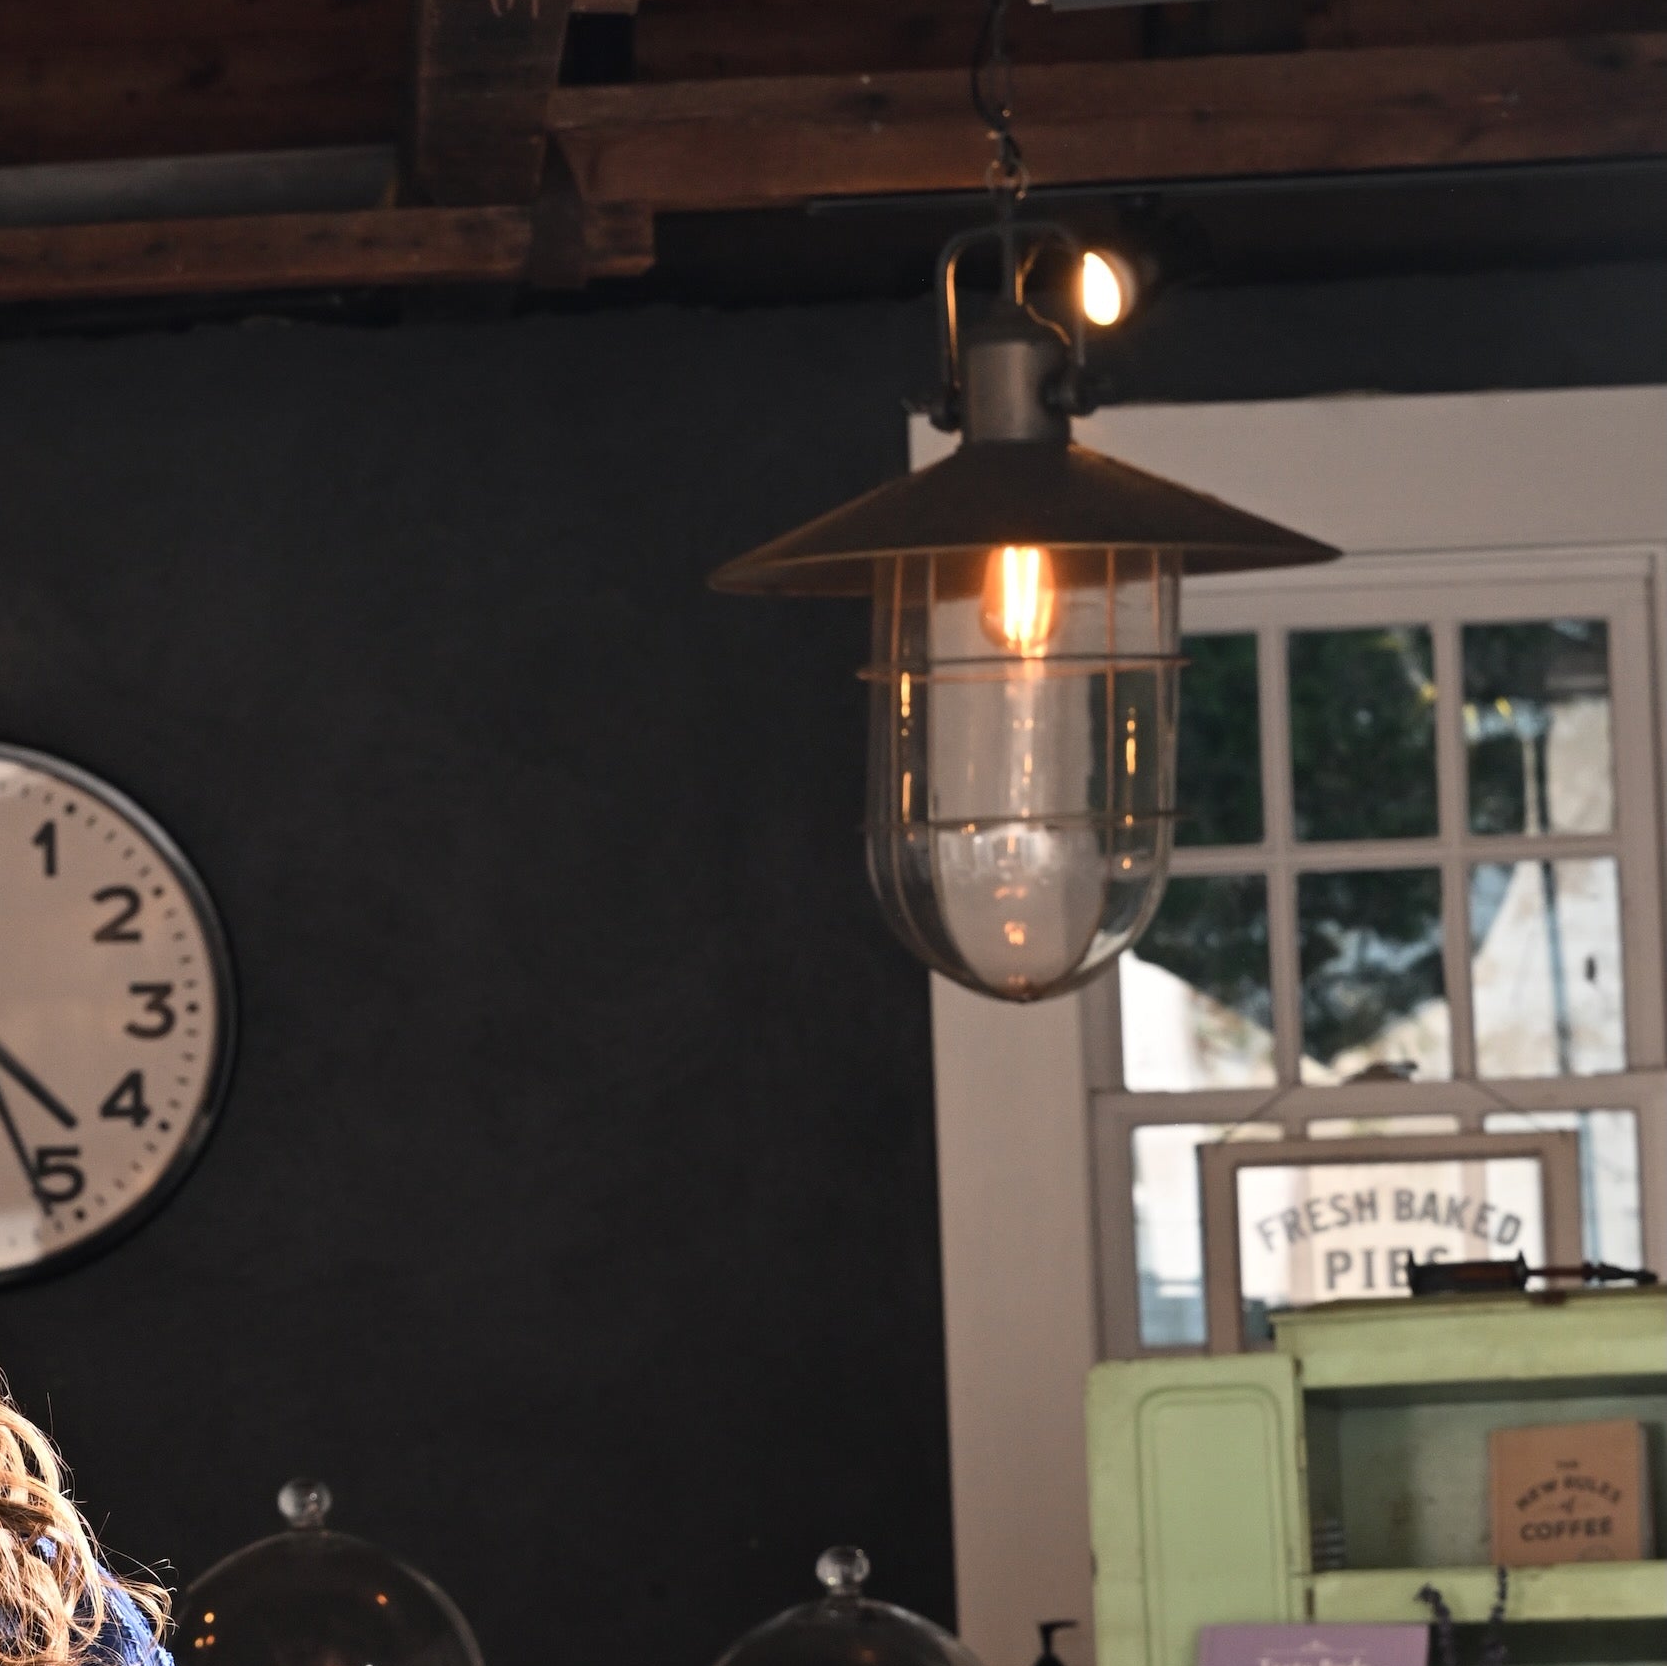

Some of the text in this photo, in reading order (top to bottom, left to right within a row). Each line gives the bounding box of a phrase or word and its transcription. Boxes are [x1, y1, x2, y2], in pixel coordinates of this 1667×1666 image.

[33, 820, 59, 878] 1
[92, 884, 143, 944] 2
[125, 981, 177, 1040] 3
[99, 1070, 152, 1129] 4
[35, 1147, 85, 1203] 5
[1255, 1188, 1522, 1252] FRESH BAKED
[1519, 1515, 1613, 1542] COFFEE
